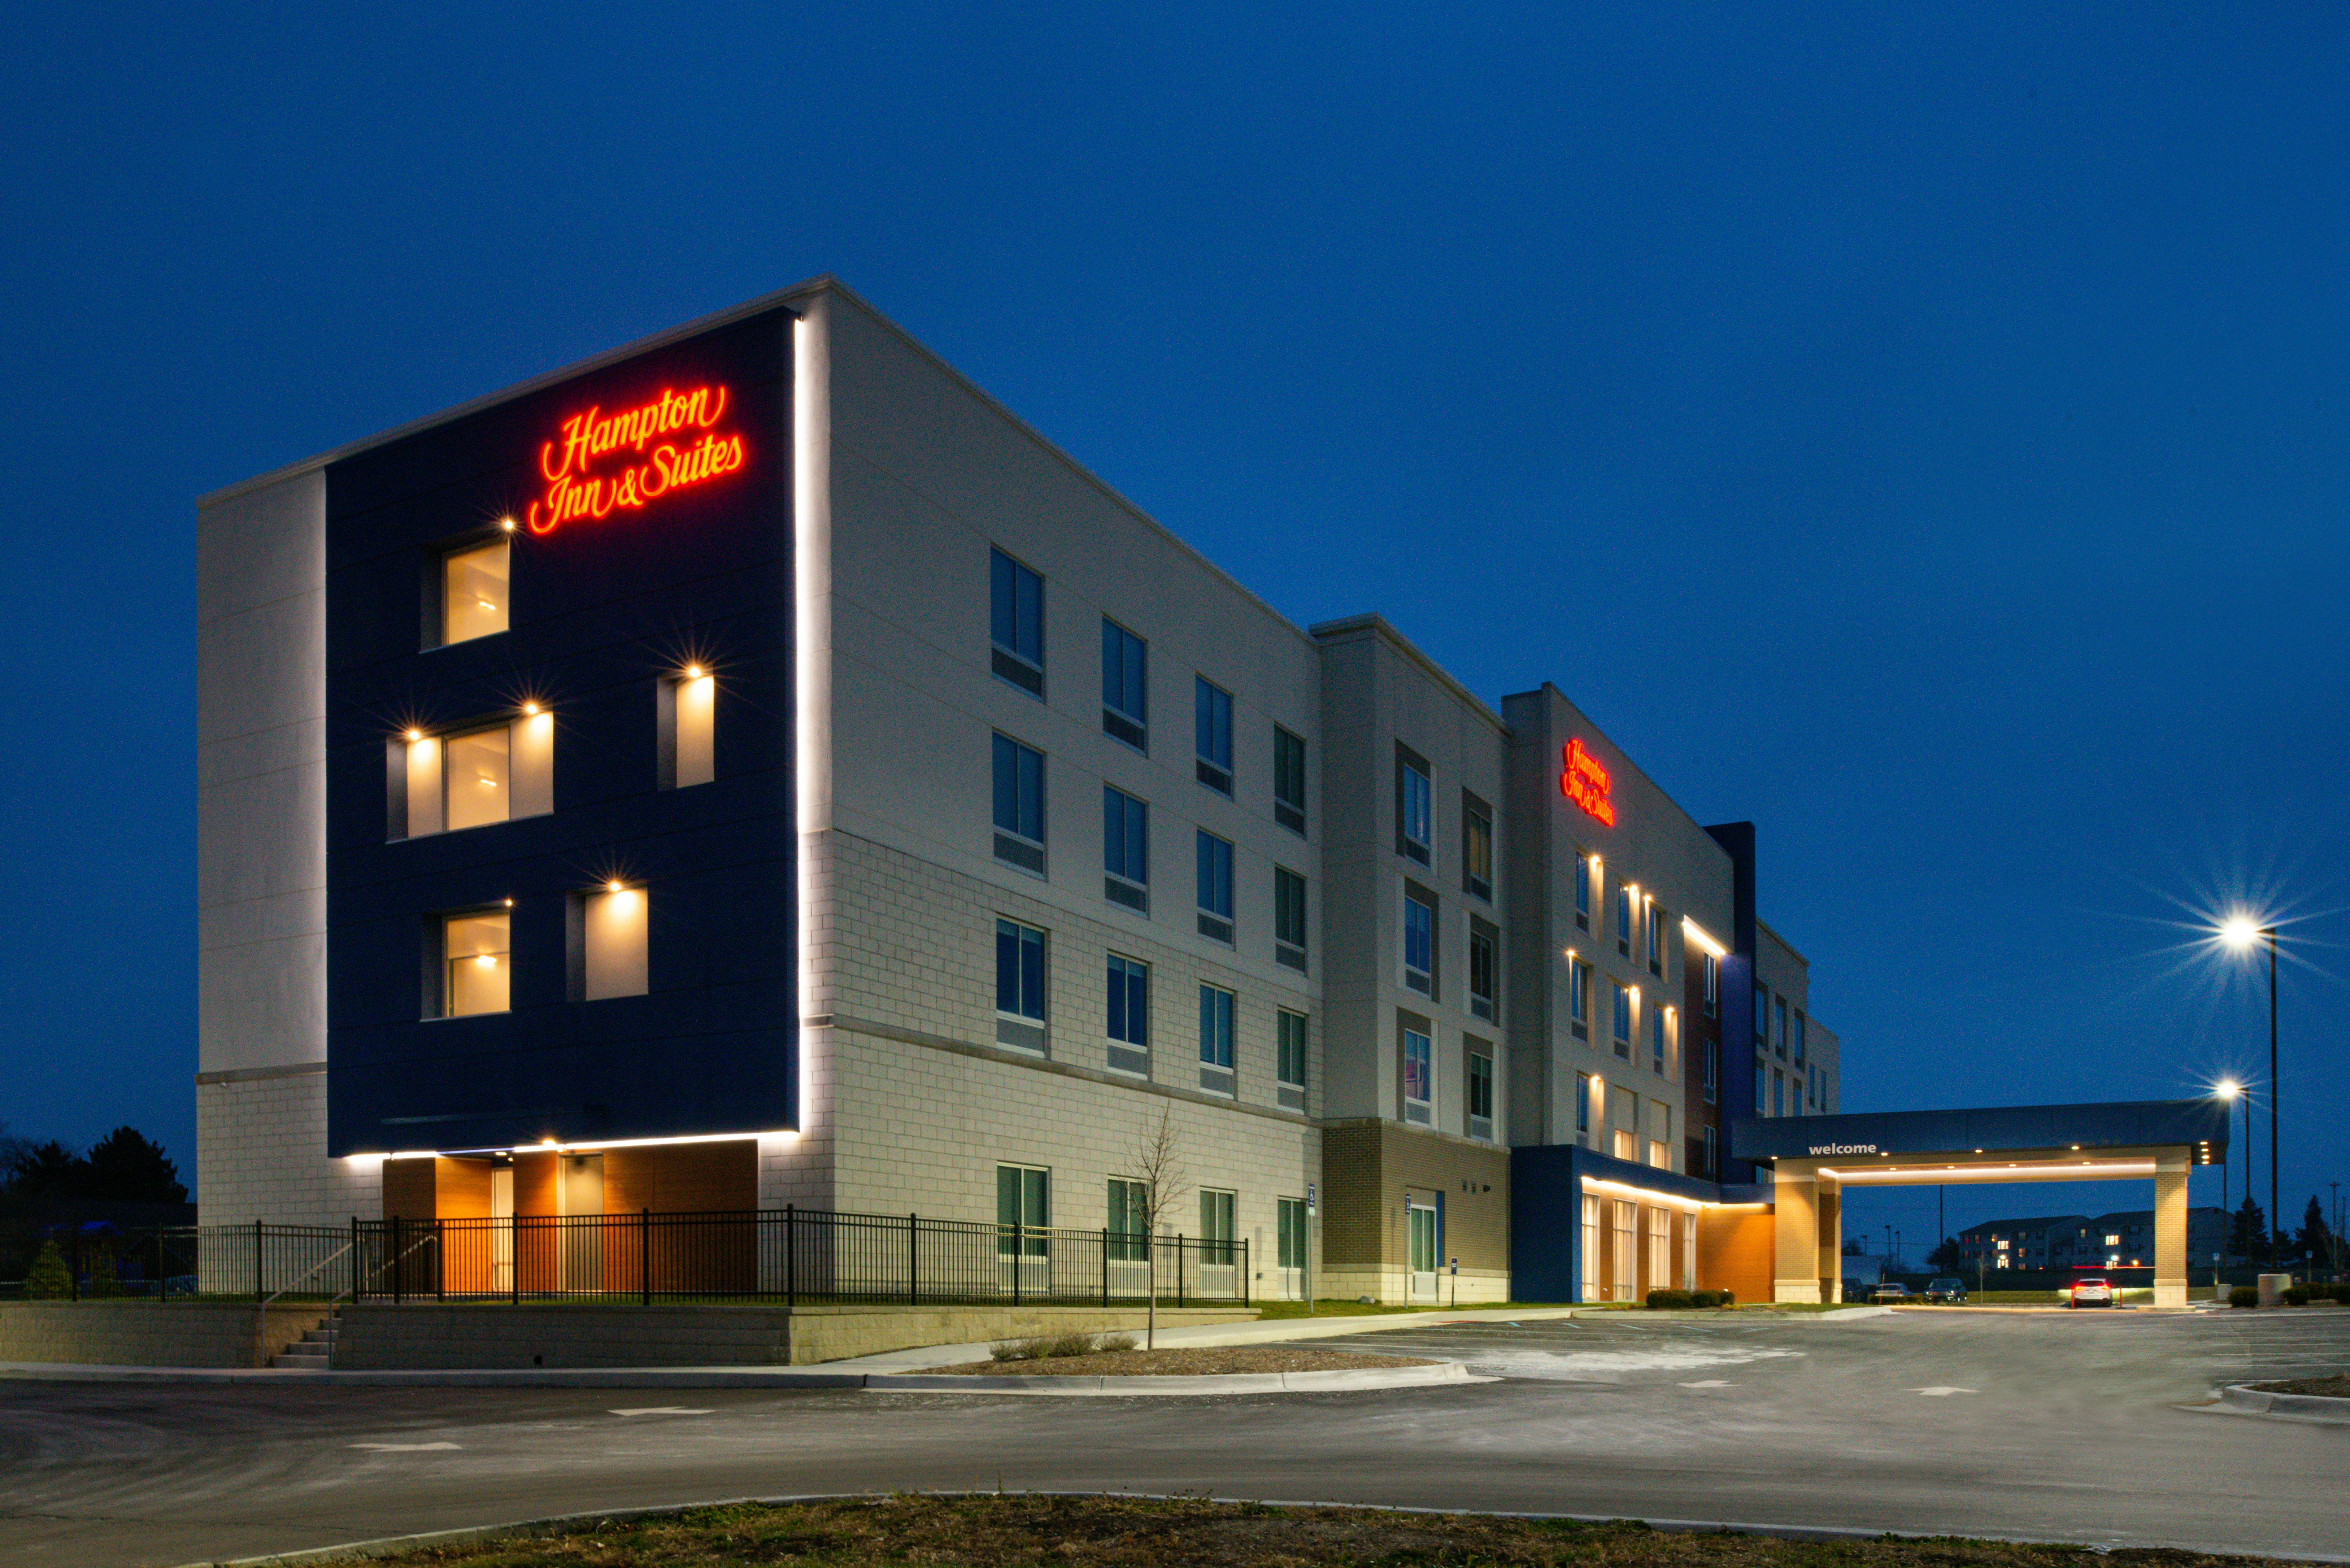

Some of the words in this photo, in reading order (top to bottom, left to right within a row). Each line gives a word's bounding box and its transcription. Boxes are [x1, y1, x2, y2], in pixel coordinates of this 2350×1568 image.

[542, 386, 725, 482] Hampton
[529, 475, 617, 533] Inn
[616, 469, 643, 506] &
[639, 434, 742, 497] Suites
[1567, 739, 1610, 794] Hampton
[1564, 770, 1587, 806] Inn
[1590, 789, 1613, 826] Suites
[1809, 1142, 1877, 1155] welcome
